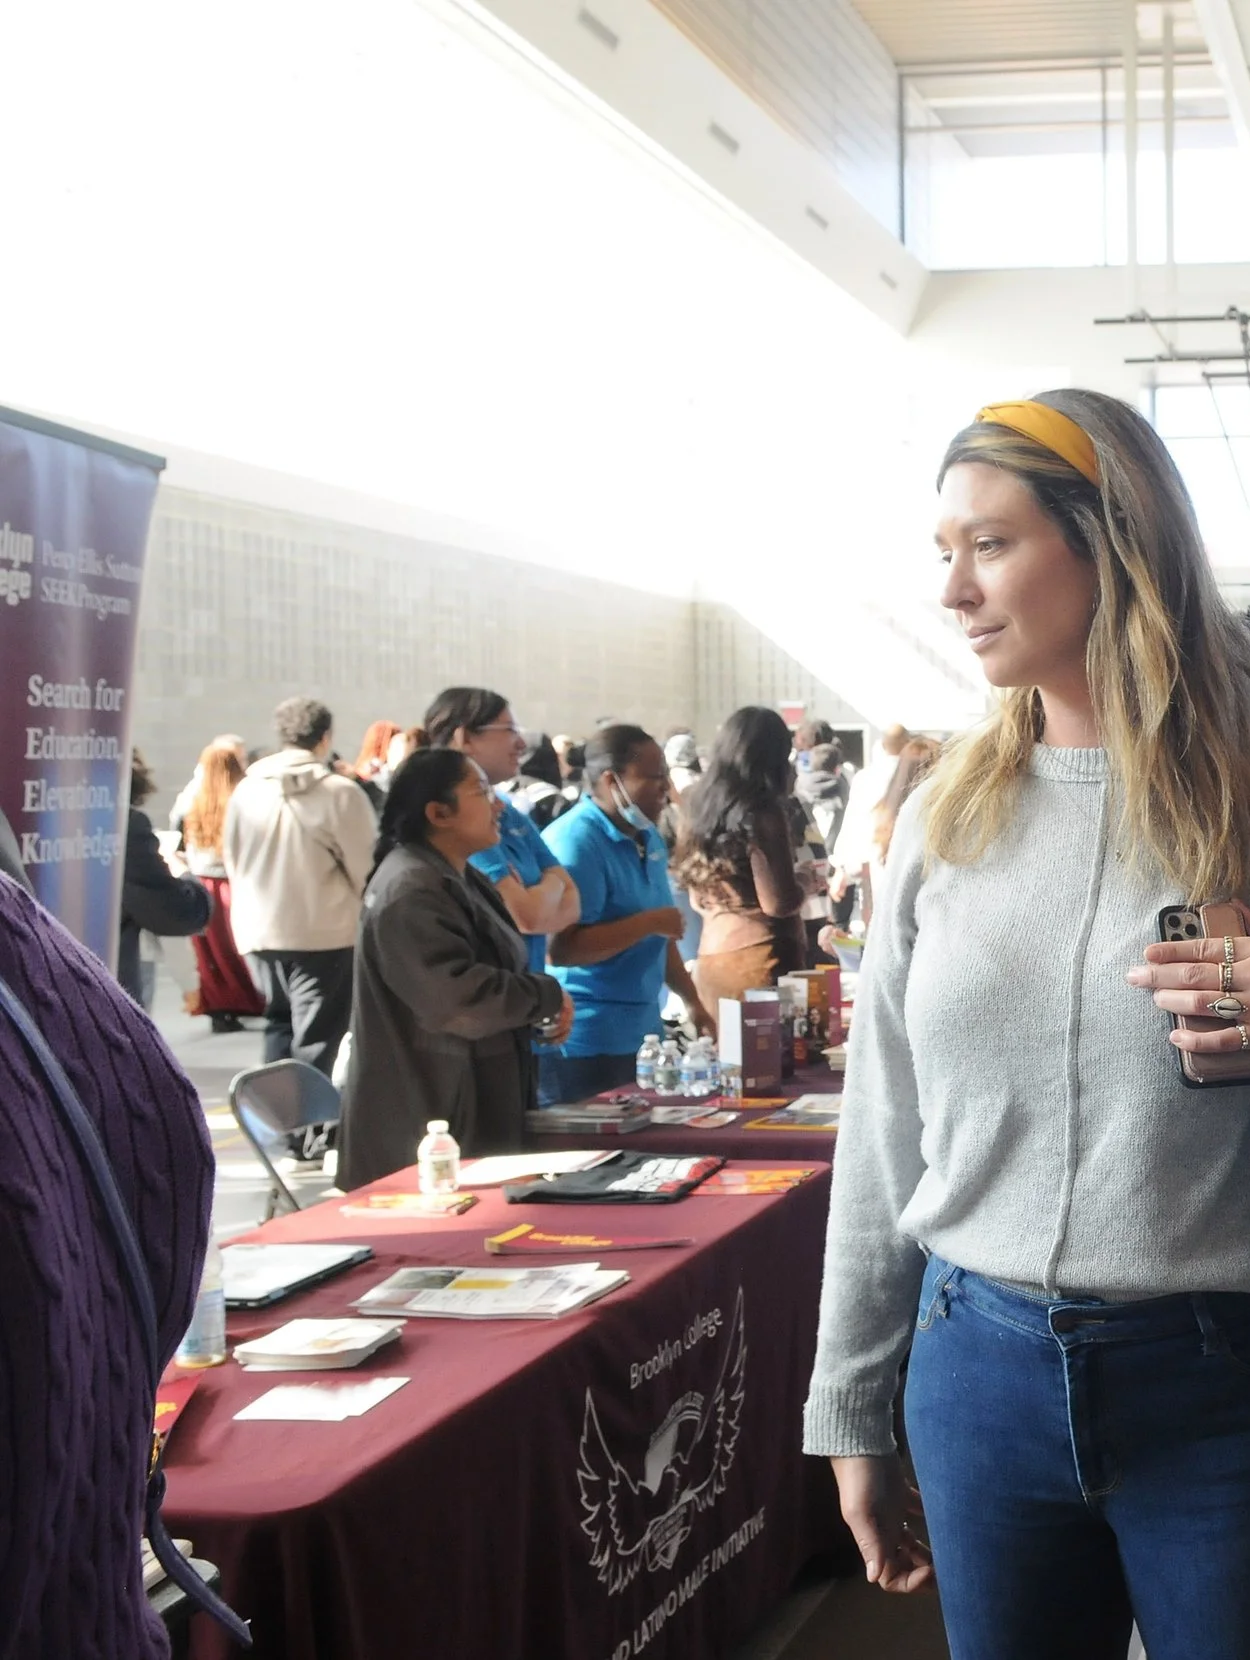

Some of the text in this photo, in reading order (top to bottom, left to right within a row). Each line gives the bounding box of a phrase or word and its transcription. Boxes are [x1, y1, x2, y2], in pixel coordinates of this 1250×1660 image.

[27, 674, 125, 712] Search for
[21, 826, 121, 866] Knowledge
